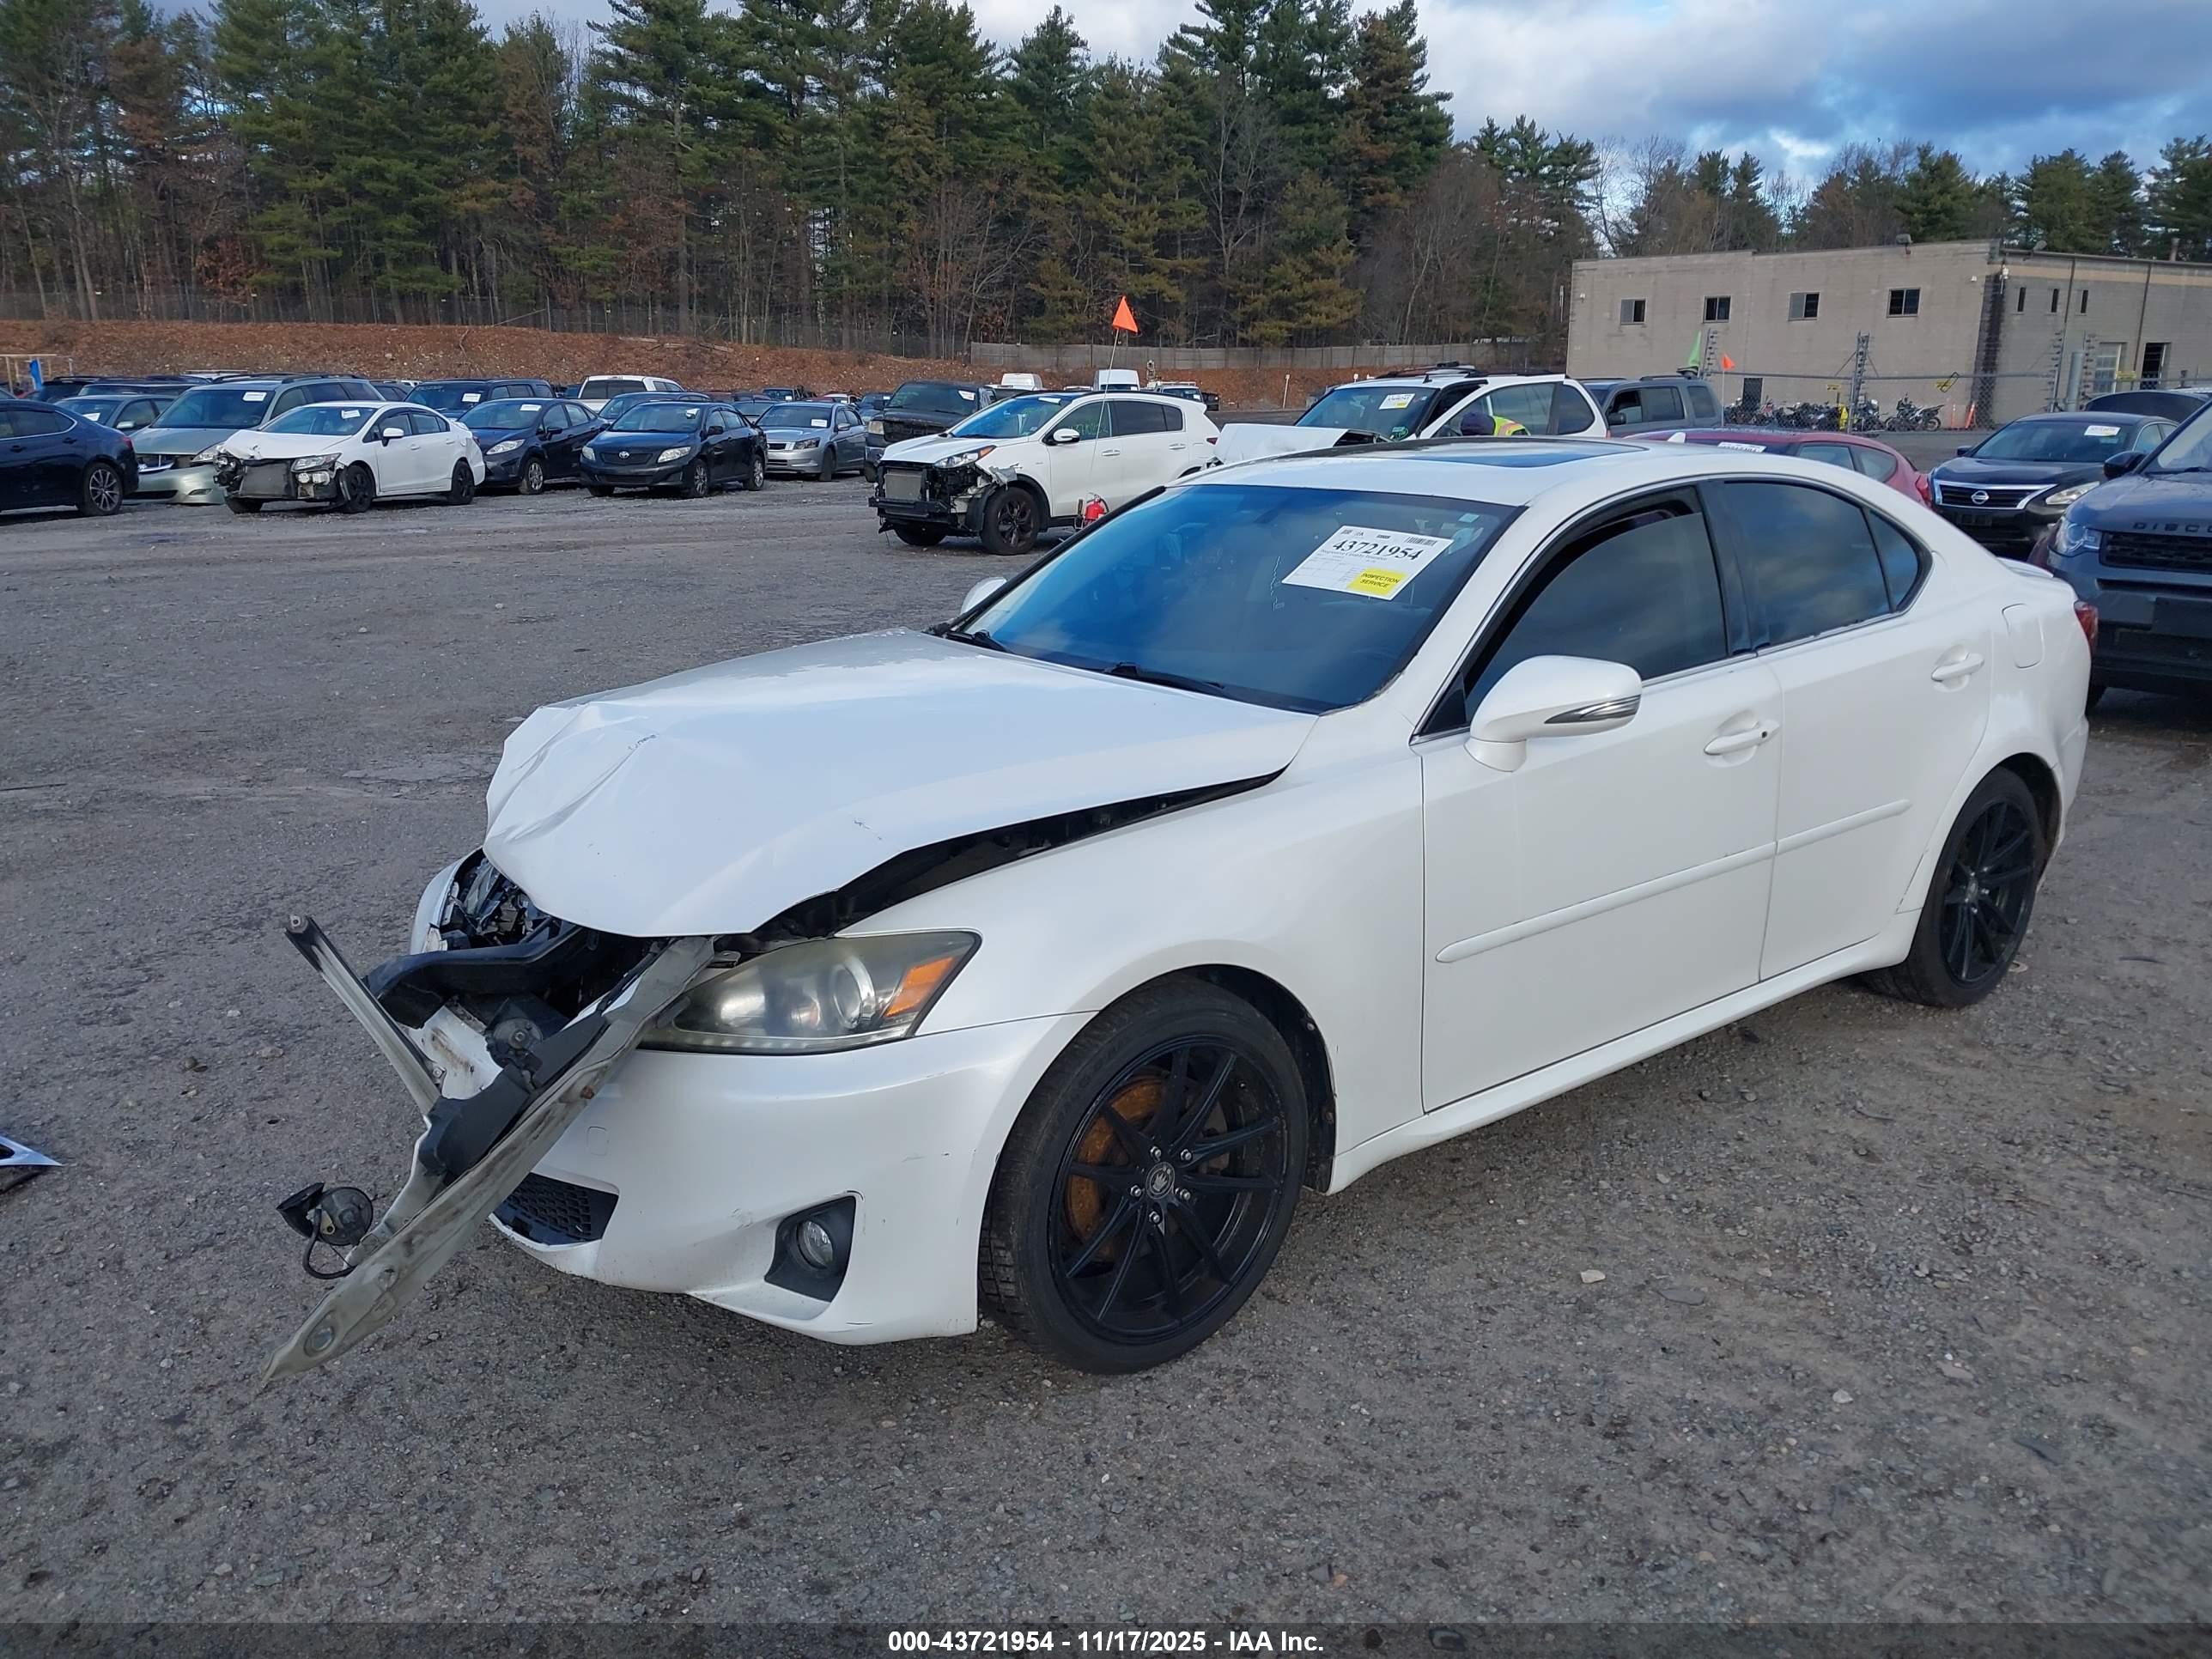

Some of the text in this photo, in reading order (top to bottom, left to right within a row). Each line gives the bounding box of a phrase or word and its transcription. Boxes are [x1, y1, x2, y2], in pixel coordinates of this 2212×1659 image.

[1333, 539, 1424, 560] 43721954
[1360, 573, 1401, 584] INSPECTION
[1360, 579, 1389, 587] SERVICE
